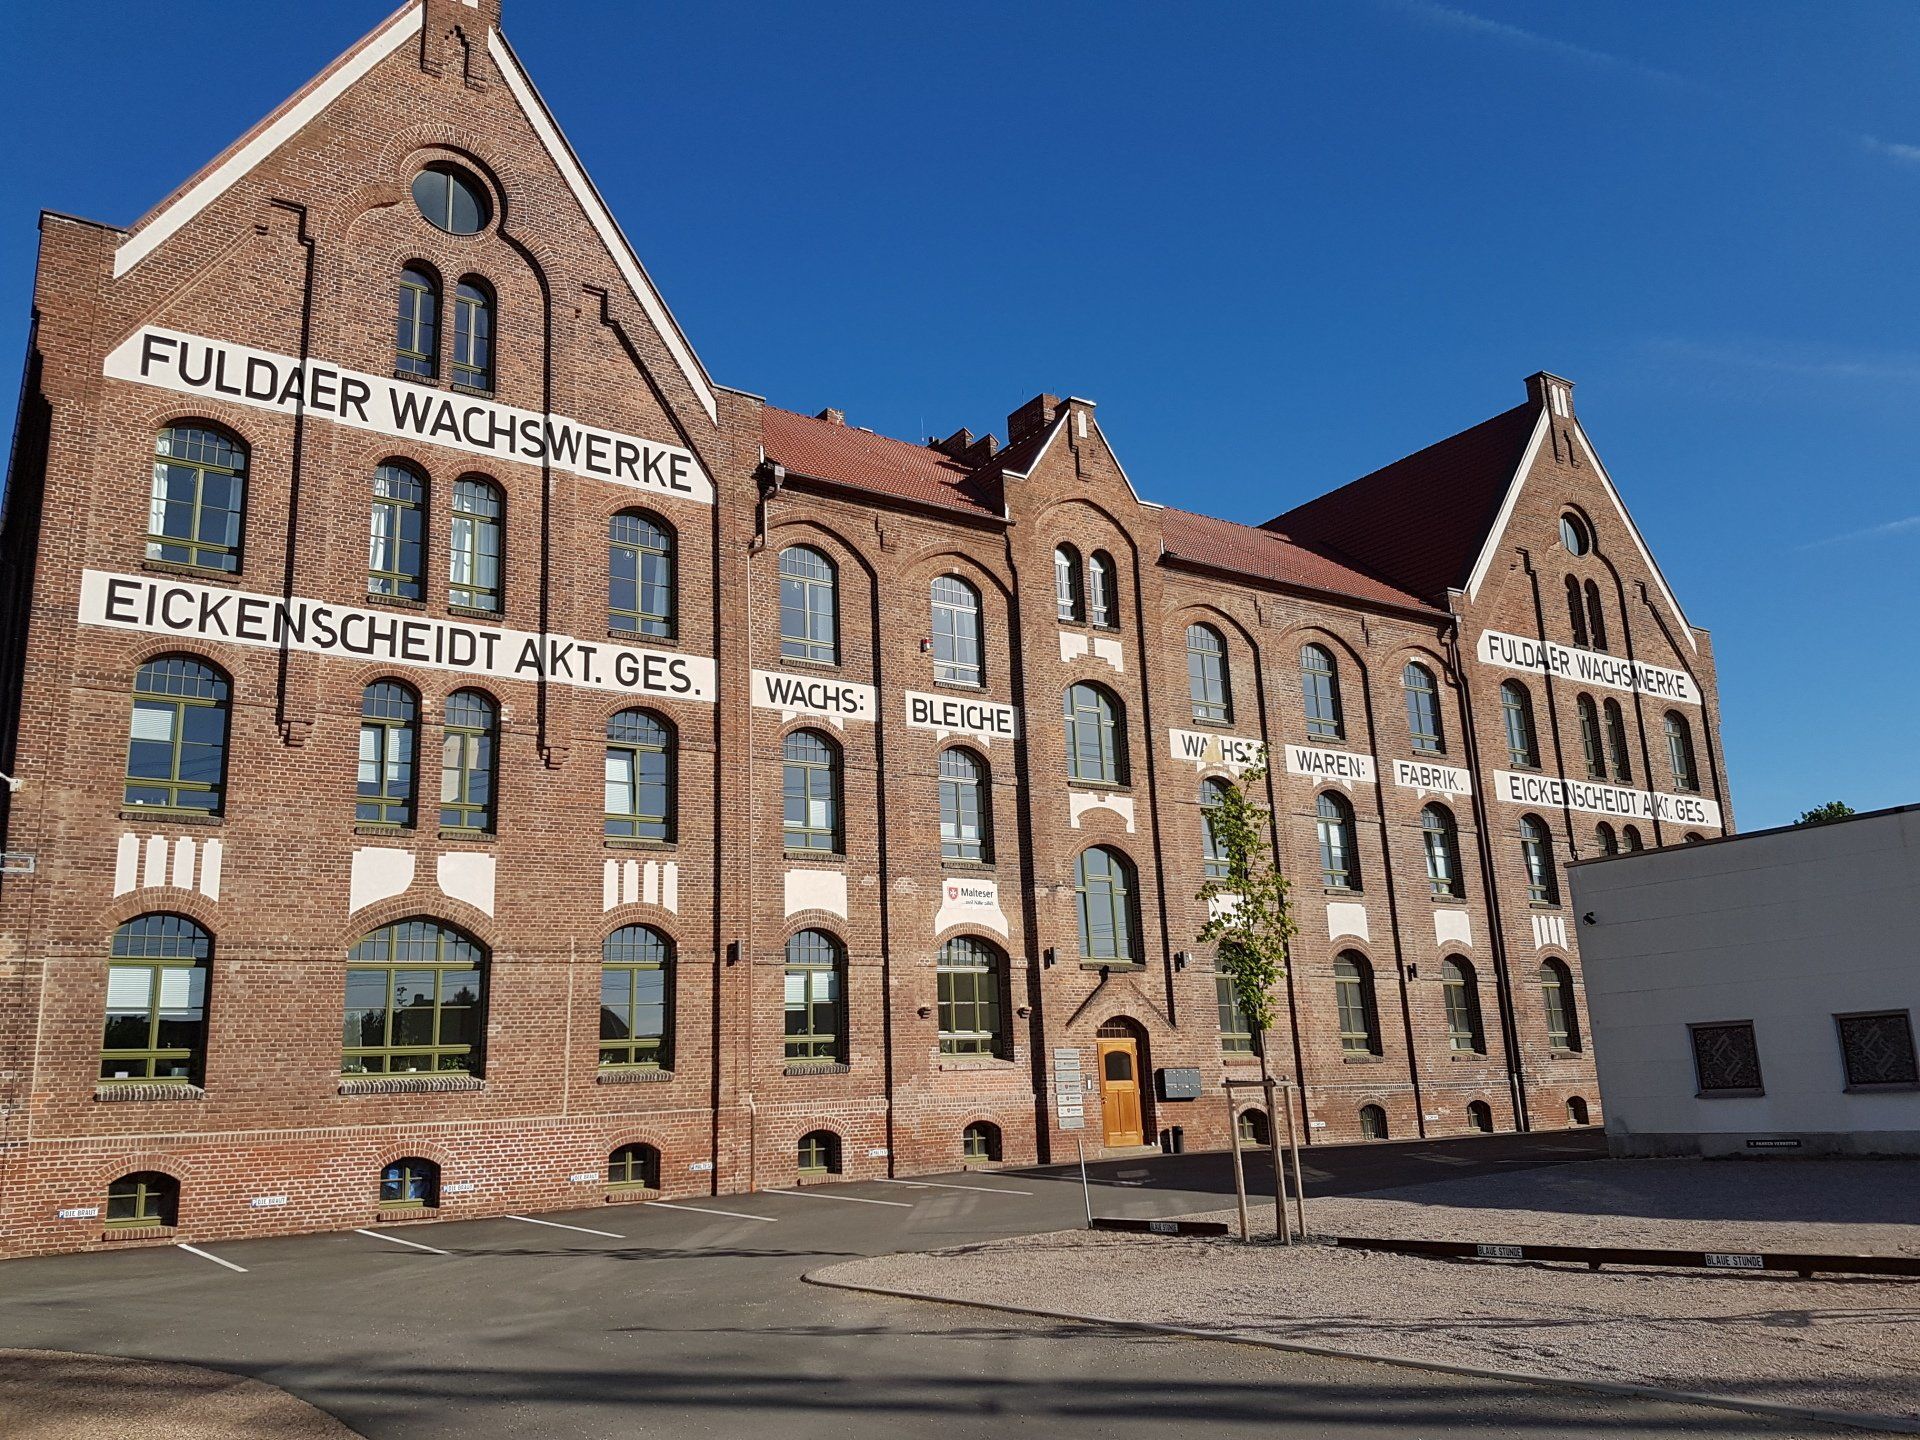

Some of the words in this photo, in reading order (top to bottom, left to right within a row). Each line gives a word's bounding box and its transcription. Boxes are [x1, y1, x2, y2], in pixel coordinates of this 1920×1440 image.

[140, 334, 371, 423] FULDAER
[388, 387, 693, 493] WACHSWERKE
[105, 578, 502, 671] EICKENSCHEIDT
[515, 639, 602, 684] AKT.
[614, 652, 702, 696] GES.
[1488, 635, 1571, 675] FULDAER
[1576, 653, 1688, 699] WACHSWERKE
[765, 676, 864, 713] WACHS:
[912, 698, 1012, 733] BLEICHE
[1296, 749, 1366, 778] WAREN:
[1400, 763, 1464, 791] FABRIK.
[1509, 775, 1637, 815] EICKENSCHEIDT
[1643, 794, 1673, 819] AKT.
[1675, 799, 1709, 824] GES.
[960, 887, 994, 898] Malteser
[1478, 1245, 1497, 1256] BLAUE
[1498, 1246, 1522, 1257] STUNDE
[1706, 1254, 1730, 1266] BLAUE
[1732, 1255, 1762, 1267] STUNDE
